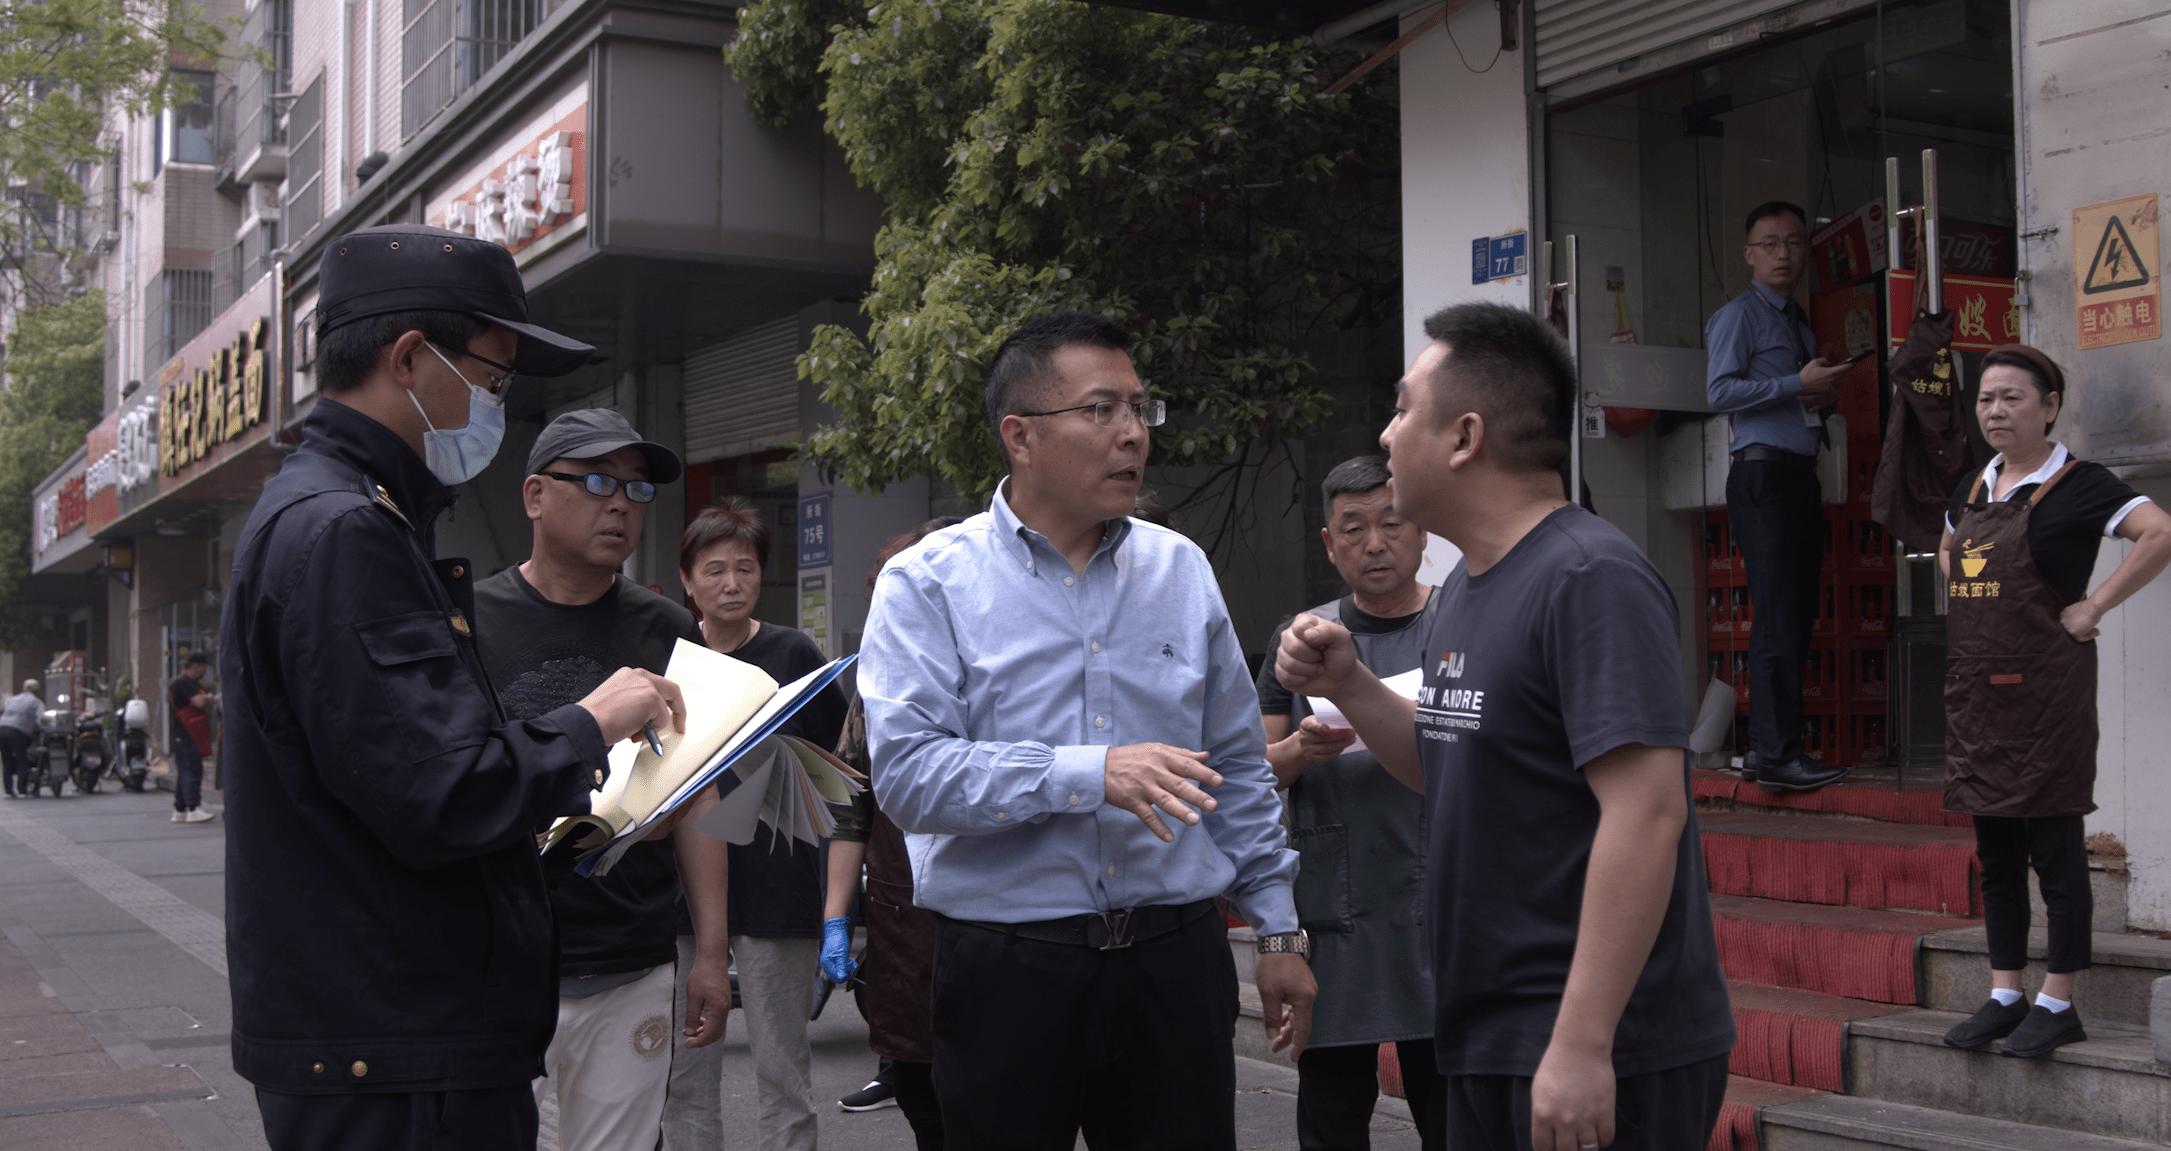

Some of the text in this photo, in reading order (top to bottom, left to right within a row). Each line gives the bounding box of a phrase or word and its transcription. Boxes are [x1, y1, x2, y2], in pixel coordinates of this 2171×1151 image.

[1496, 256, 1509, 273] 77
[2082, 300, 2153, 333] 当心触电
[804, 524, 824, 544] 75号
[1437, 651, 1465, 678] FILA
